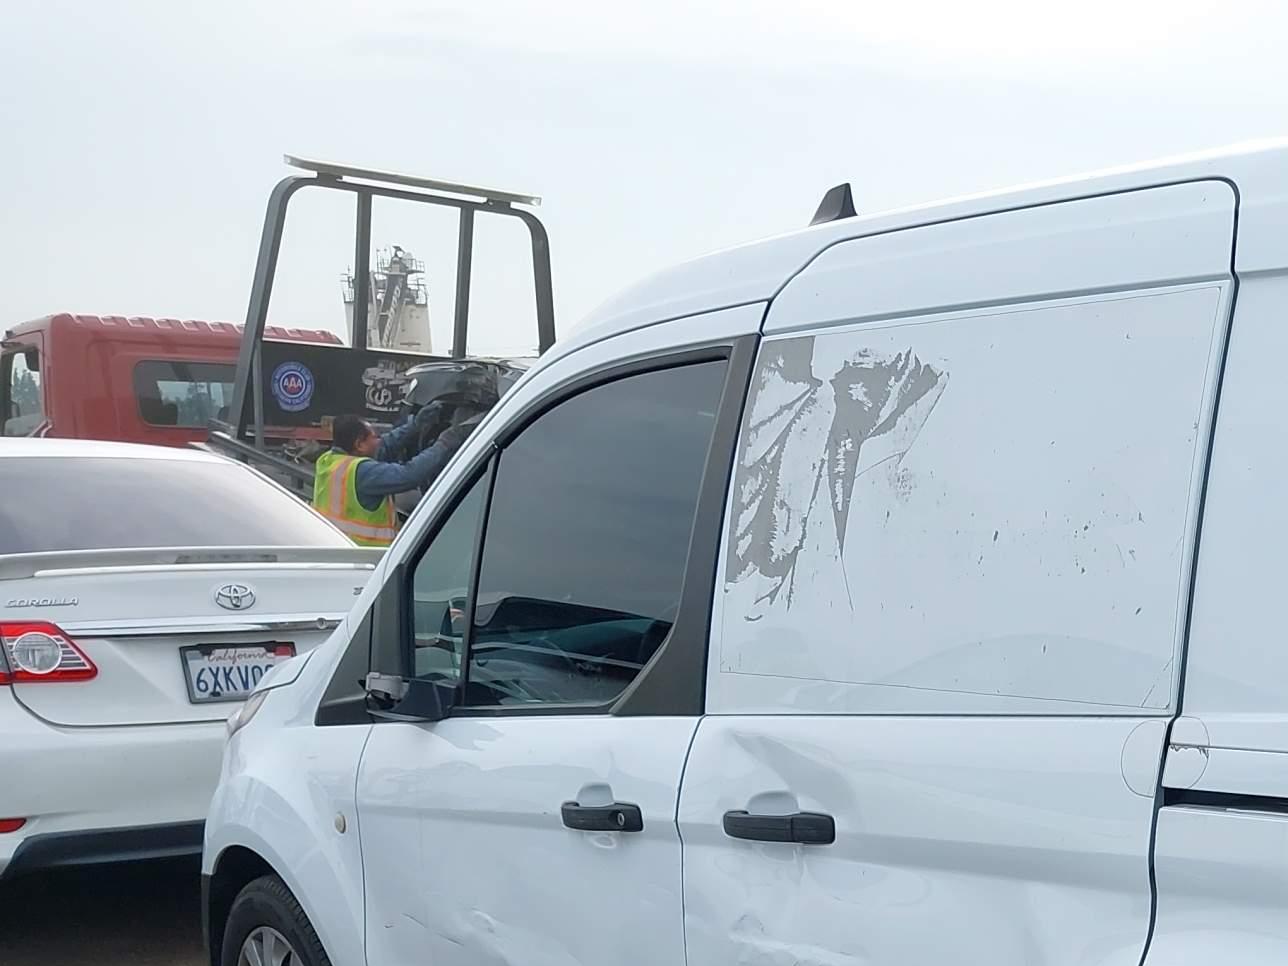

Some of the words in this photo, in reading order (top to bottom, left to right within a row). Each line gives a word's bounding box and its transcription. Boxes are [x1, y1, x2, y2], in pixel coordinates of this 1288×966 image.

[283, 376, 302, 388] AAA
[5, 598, 79, 608] COROLLA
[208, 649, 272, 664] California
[196, 664, 274, 692] 6XKV0
